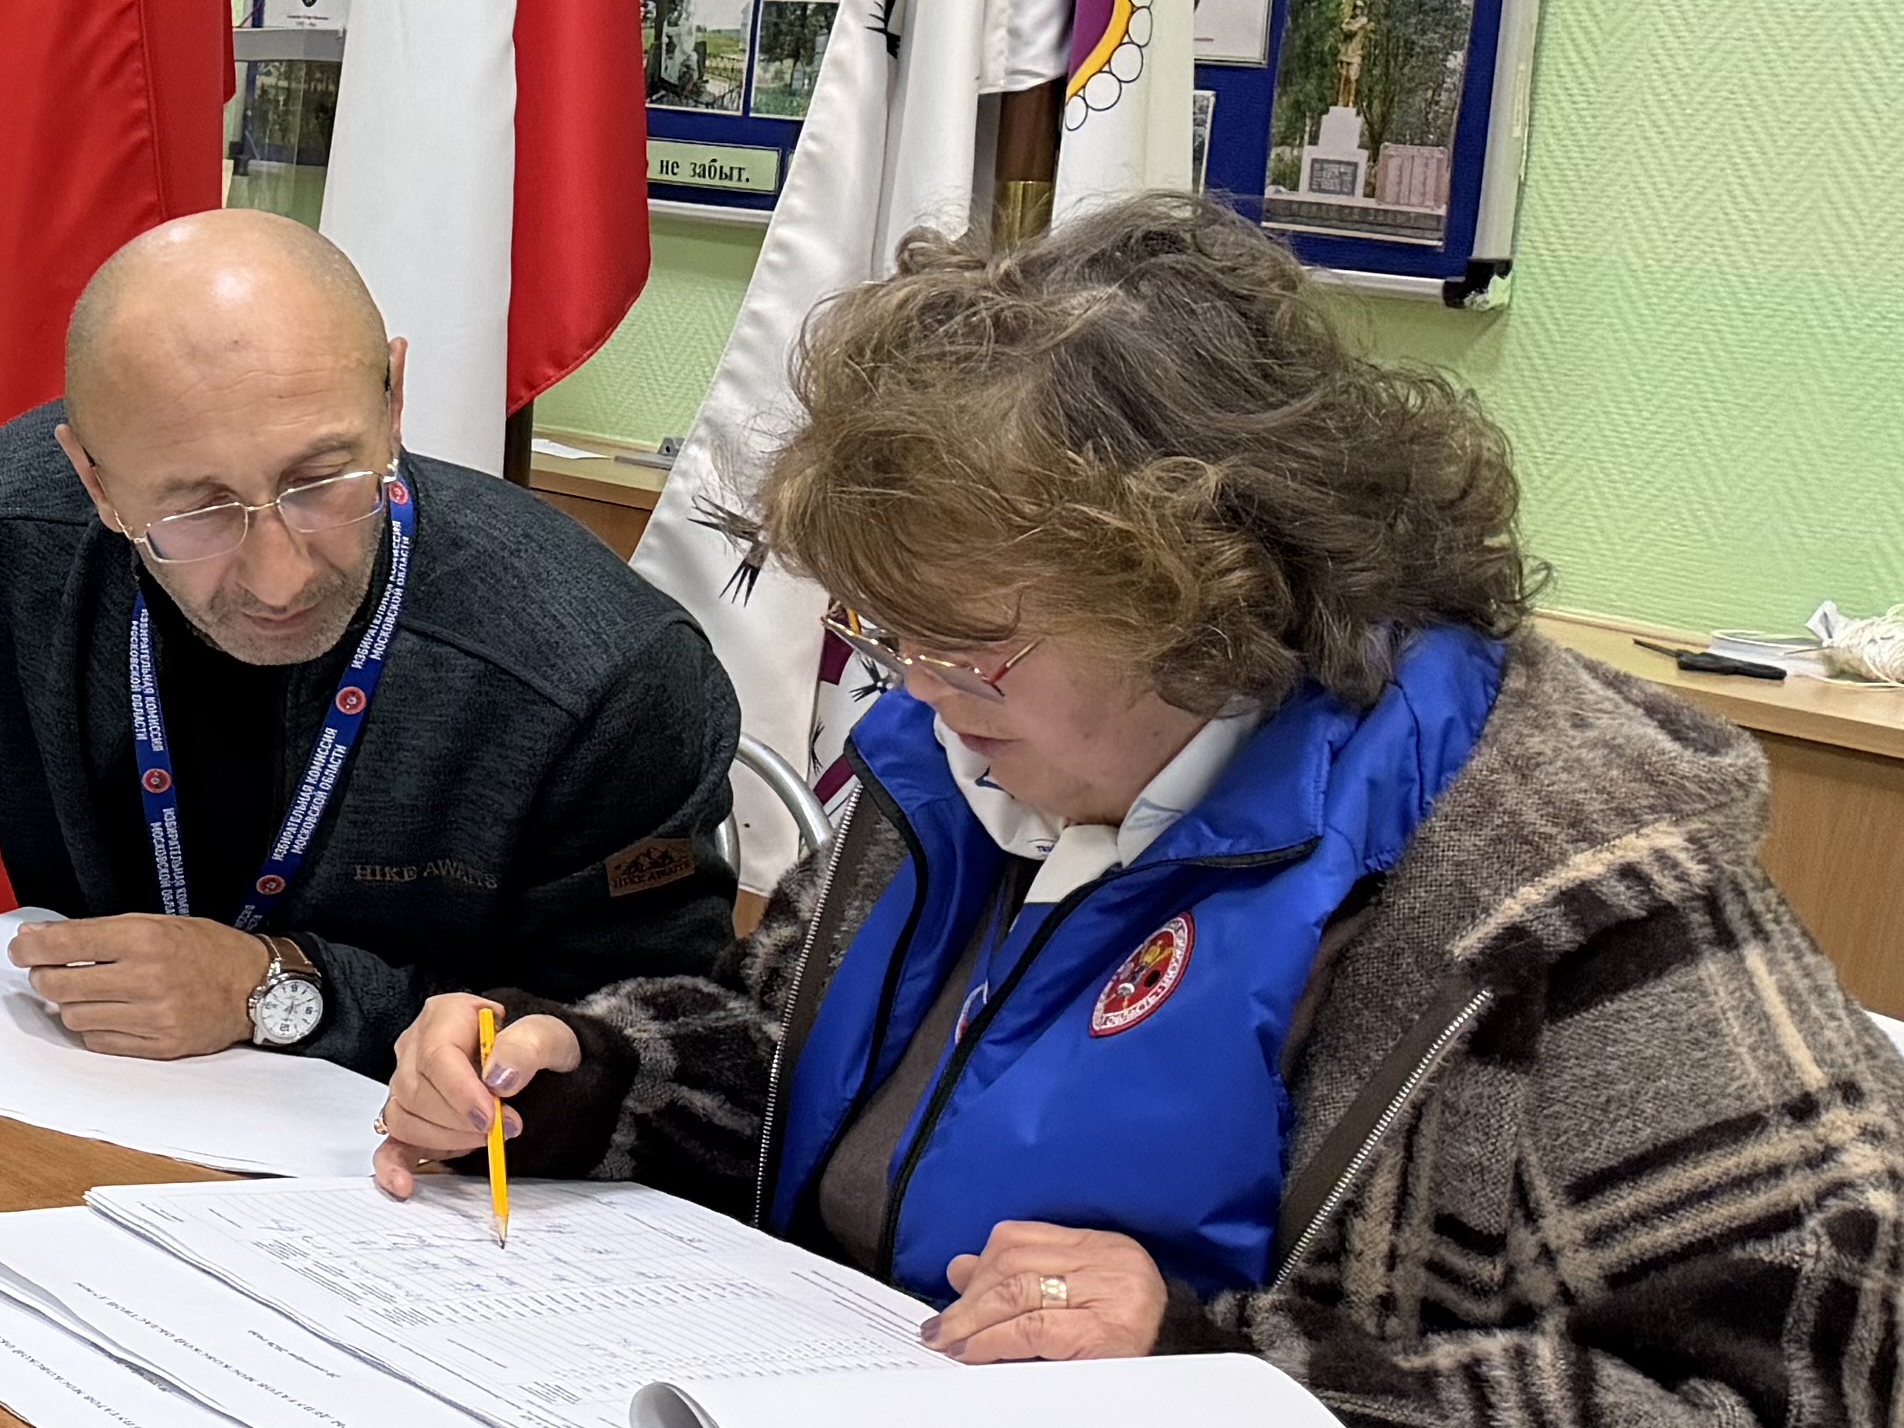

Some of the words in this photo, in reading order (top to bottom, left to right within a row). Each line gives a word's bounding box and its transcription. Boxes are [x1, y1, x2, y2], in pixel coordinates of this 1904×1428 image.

[658, 159, 680, 176] не
[690, 158, 750, 183] забыт.
[369, 589, 404, 661] МОСКОВСКОЙ
[397, 536, 410, 586] ОБЛАСТИ
[129, 620, 142, 692] МОСКОВСКОЙ
[131, 693, 148, 741] ОБЛАСТИ
[145, 696, 164, 752] КОМИССИЯ
[272, 784, 315, 862] ИЗБИРАТЕЛЬНАЯ
[305, 727, 338, 784] КОМИССИЯ
[290, 789, 328, 855] МОСКОВСКОЙ
[318, 744, 347, 791] ОБЛАСТИ
[150, 822, 171, 889] МОСКОВСКОЙ
[162, 808, 187, 888] ИЗБИРАТЕЛЬНАЯ
[354, 864, 418, 882] HIKE
[423, 858, 498, 889] AWAITS
[106, 1301, 176, 1338] ОБЛАСТНОЙ
[11, 1349, 83, 1395] МОСКОВСКОЙ
[173, 1338, 258, 1383] МОСКОВСКОЙ
[256, 1382, 334, 1419] ДЕПУТАТОВ
